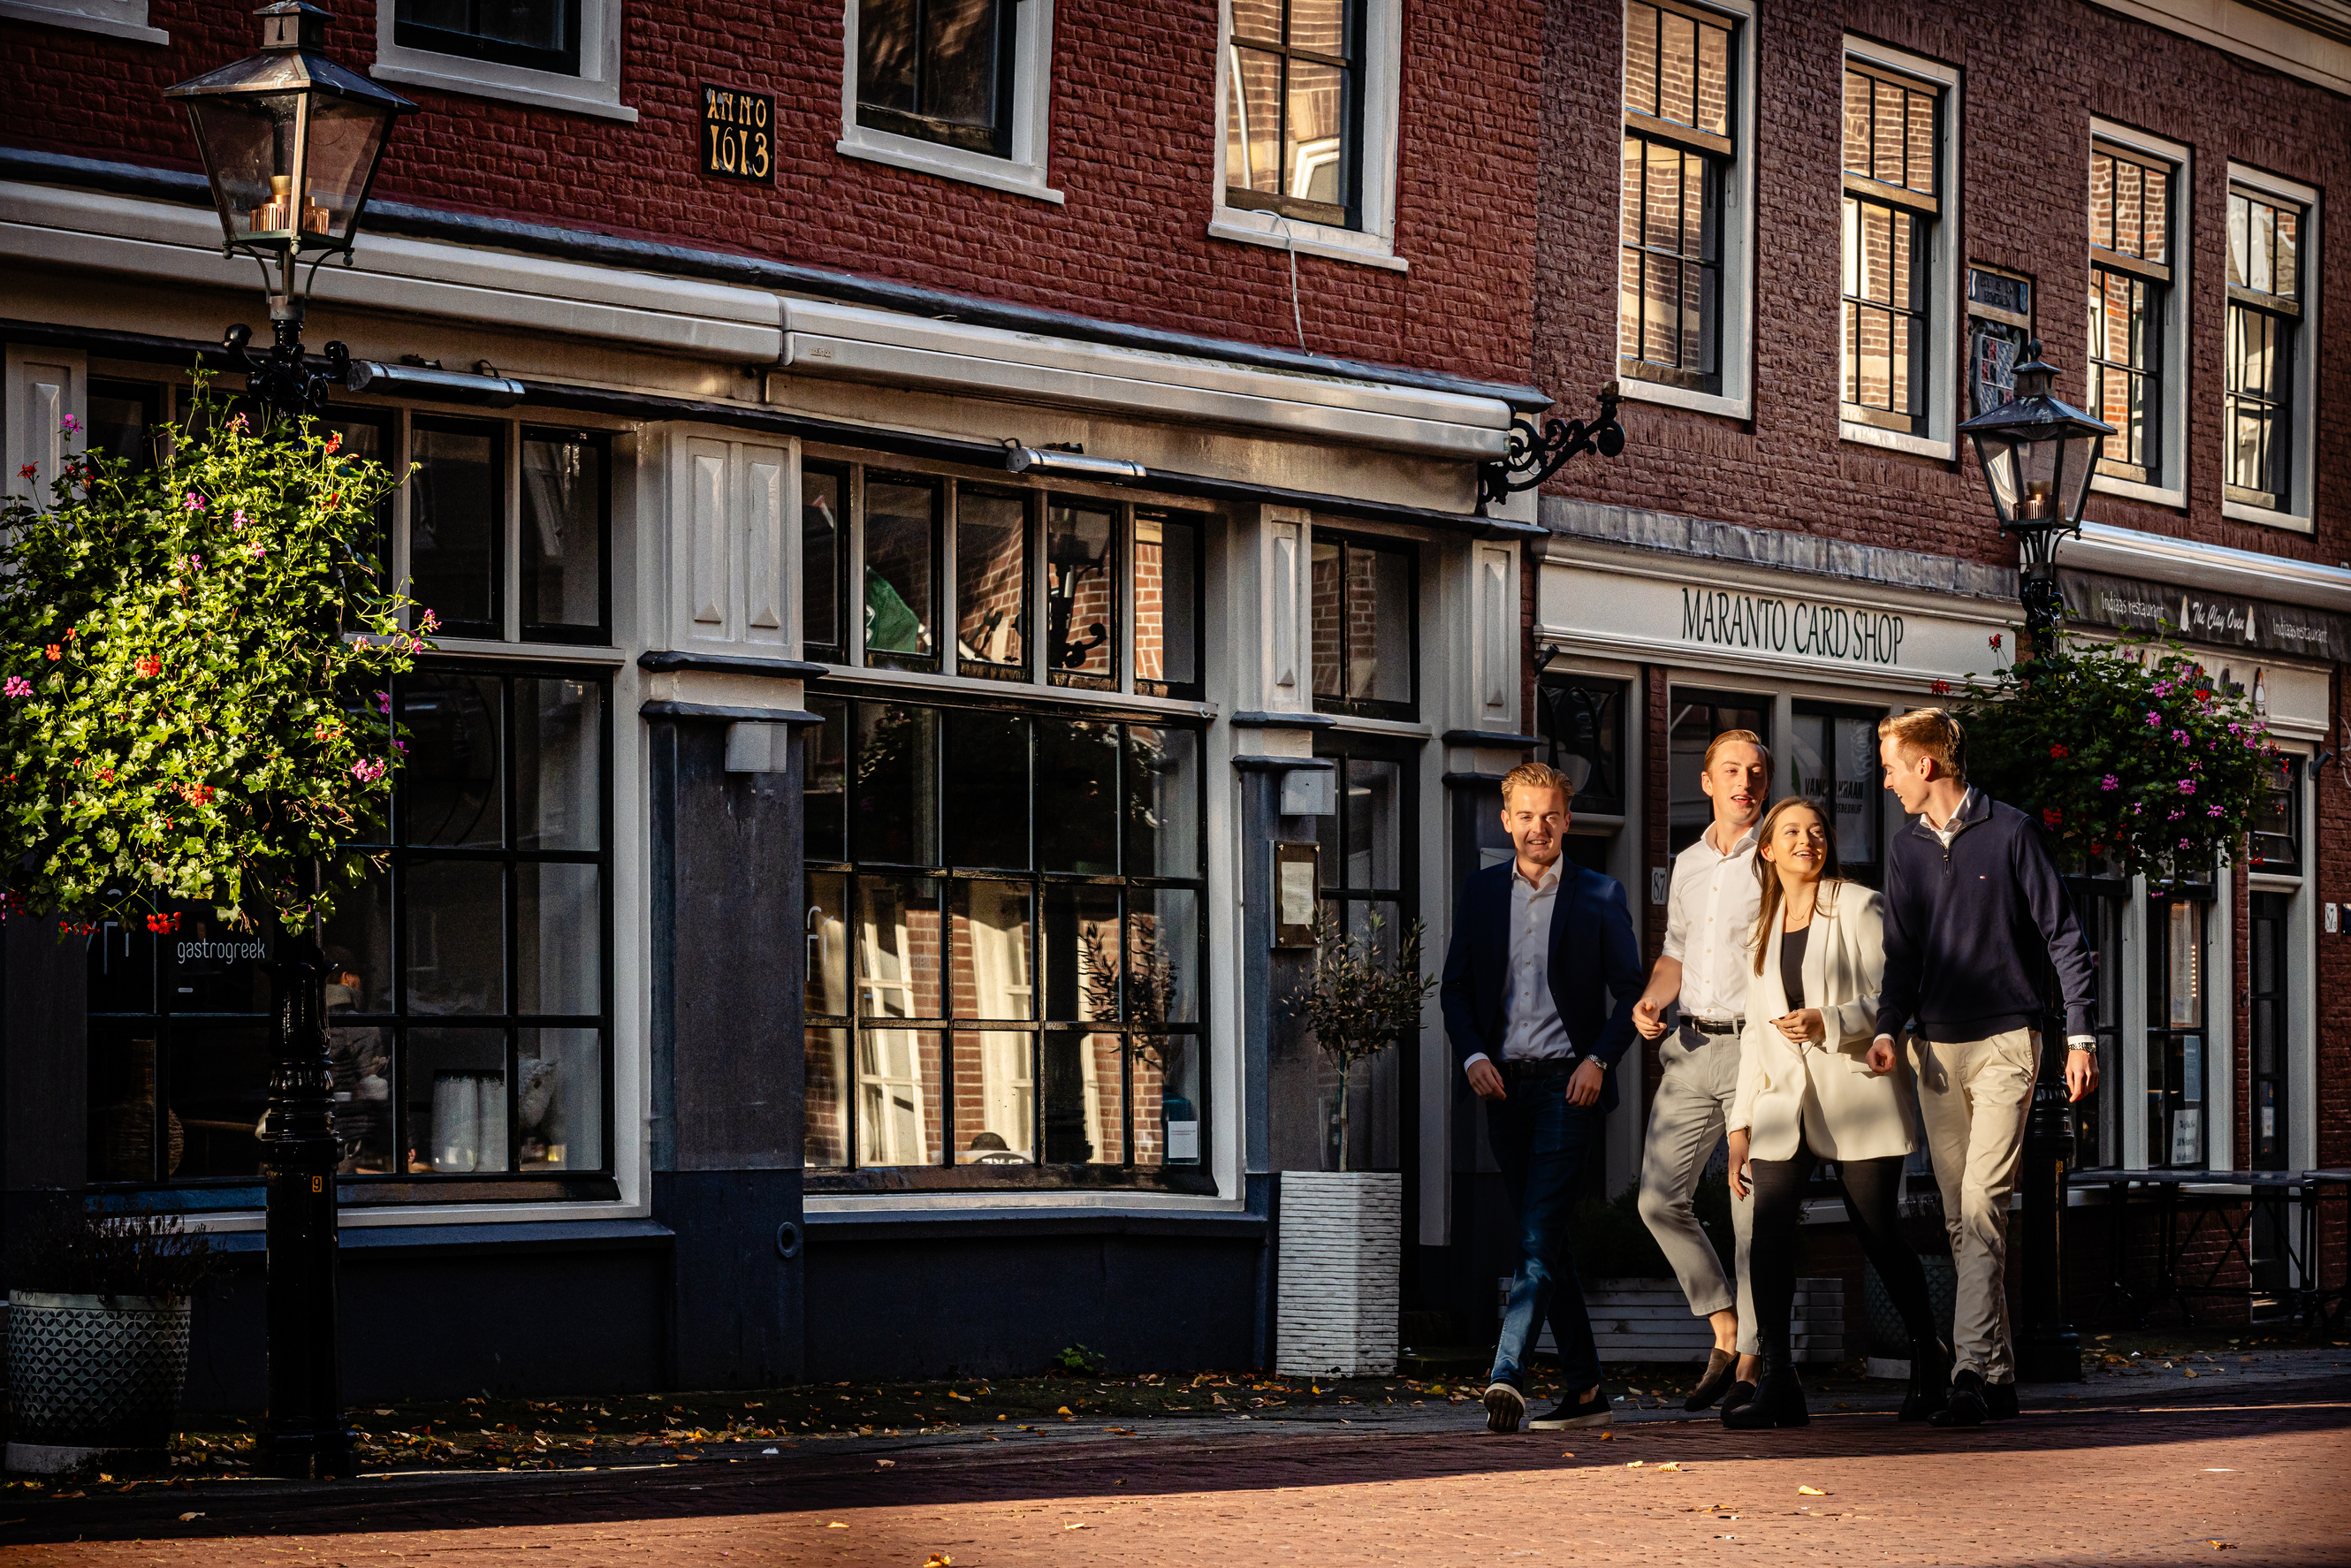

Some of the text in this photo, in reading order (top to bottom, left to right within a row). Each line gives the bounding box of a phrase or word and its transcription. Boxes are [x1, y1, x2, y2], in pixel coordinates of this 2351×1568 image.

[710, 125, 769, 178] 1613
[1681, 587, 1904, 665] MARANTO CARD SHOP
[2192, 601, 2205, 625] The
[2207, 605, 2225, 633] Clay
[2226, 607, 2245, 630] Oven
[1654, 872, 1666, 900] 87
[177, 937, 265, 965] gastrogreek
[313, 1176, 322, 1191] 9
